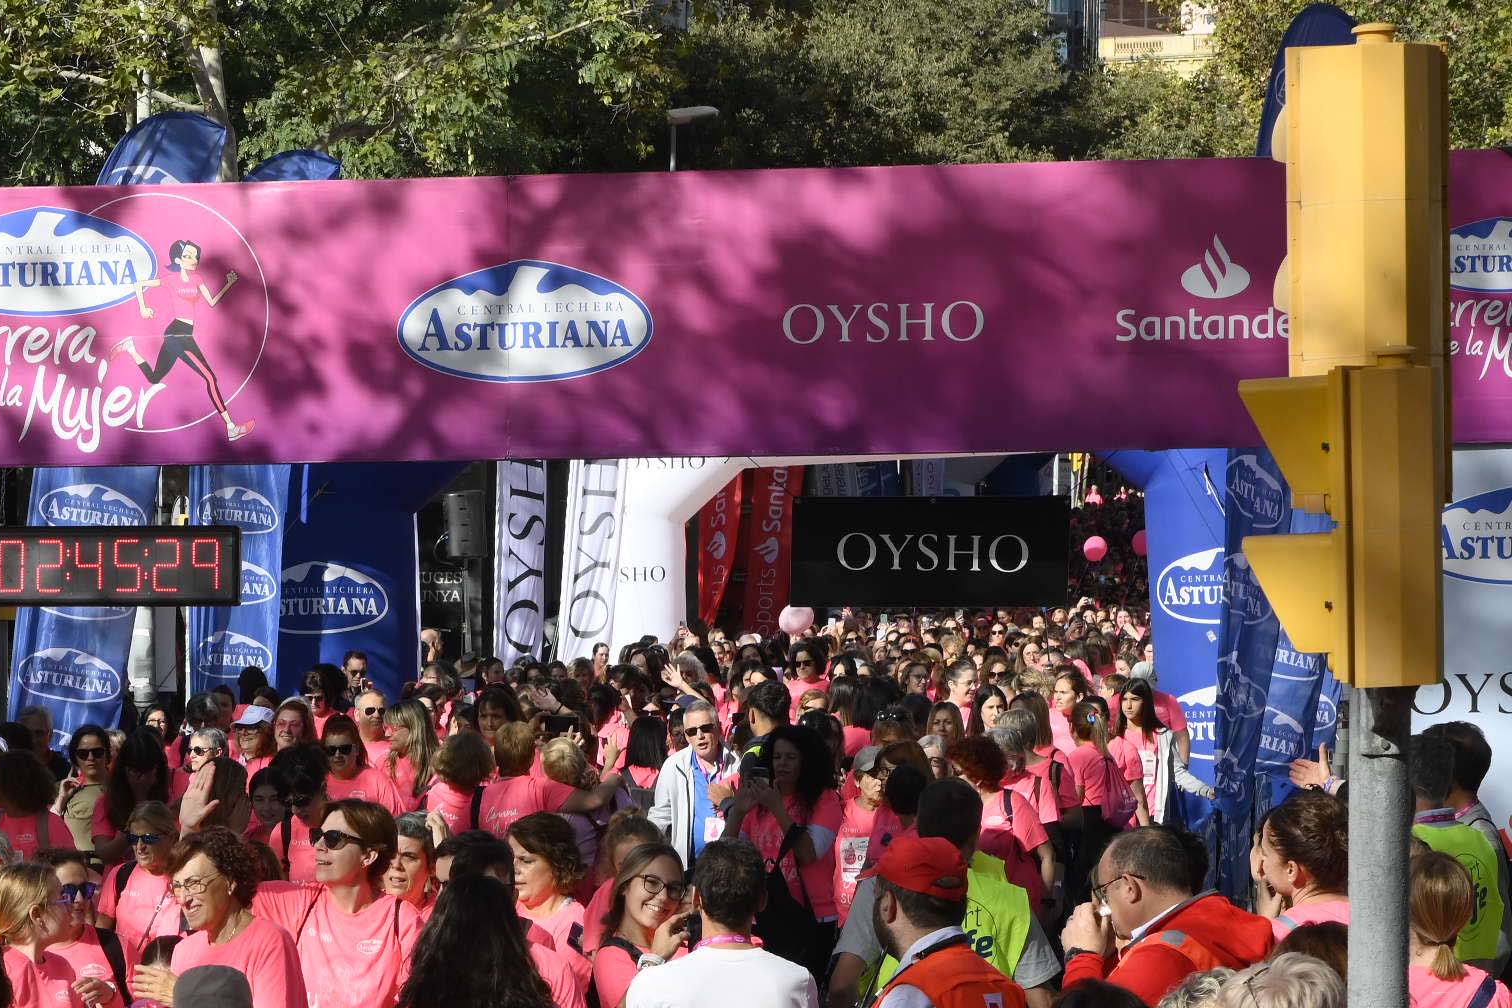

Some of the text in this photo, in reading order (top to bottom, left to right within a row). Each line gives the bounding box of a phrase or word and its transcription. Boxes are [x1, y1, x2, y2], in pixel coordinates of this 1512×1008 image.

[62, 243, 132, 255] LECHERA
[457, 301, 624, 316] CENTRAL LECHERA
[783, 301, 985, 344] OYSHO
[418, 307, 634, 353] ASTURIANA
[1115, 309, 1289, 343] Santande
[19, 359, 166, 454] Mujer
[504, 459, 545, 654] OYSH
[568, 459, 619, 641] OYSH
[837, 532, 1029, 573] OYSHO
[325, 585, 375, 595] LECHERA
[421, 571, 464, 584] UGES
[619, 565, 667, 583] SHO
[280, 597, 379, 617] STURIANA
[24, 662, 113, 695] ASTURIANA
